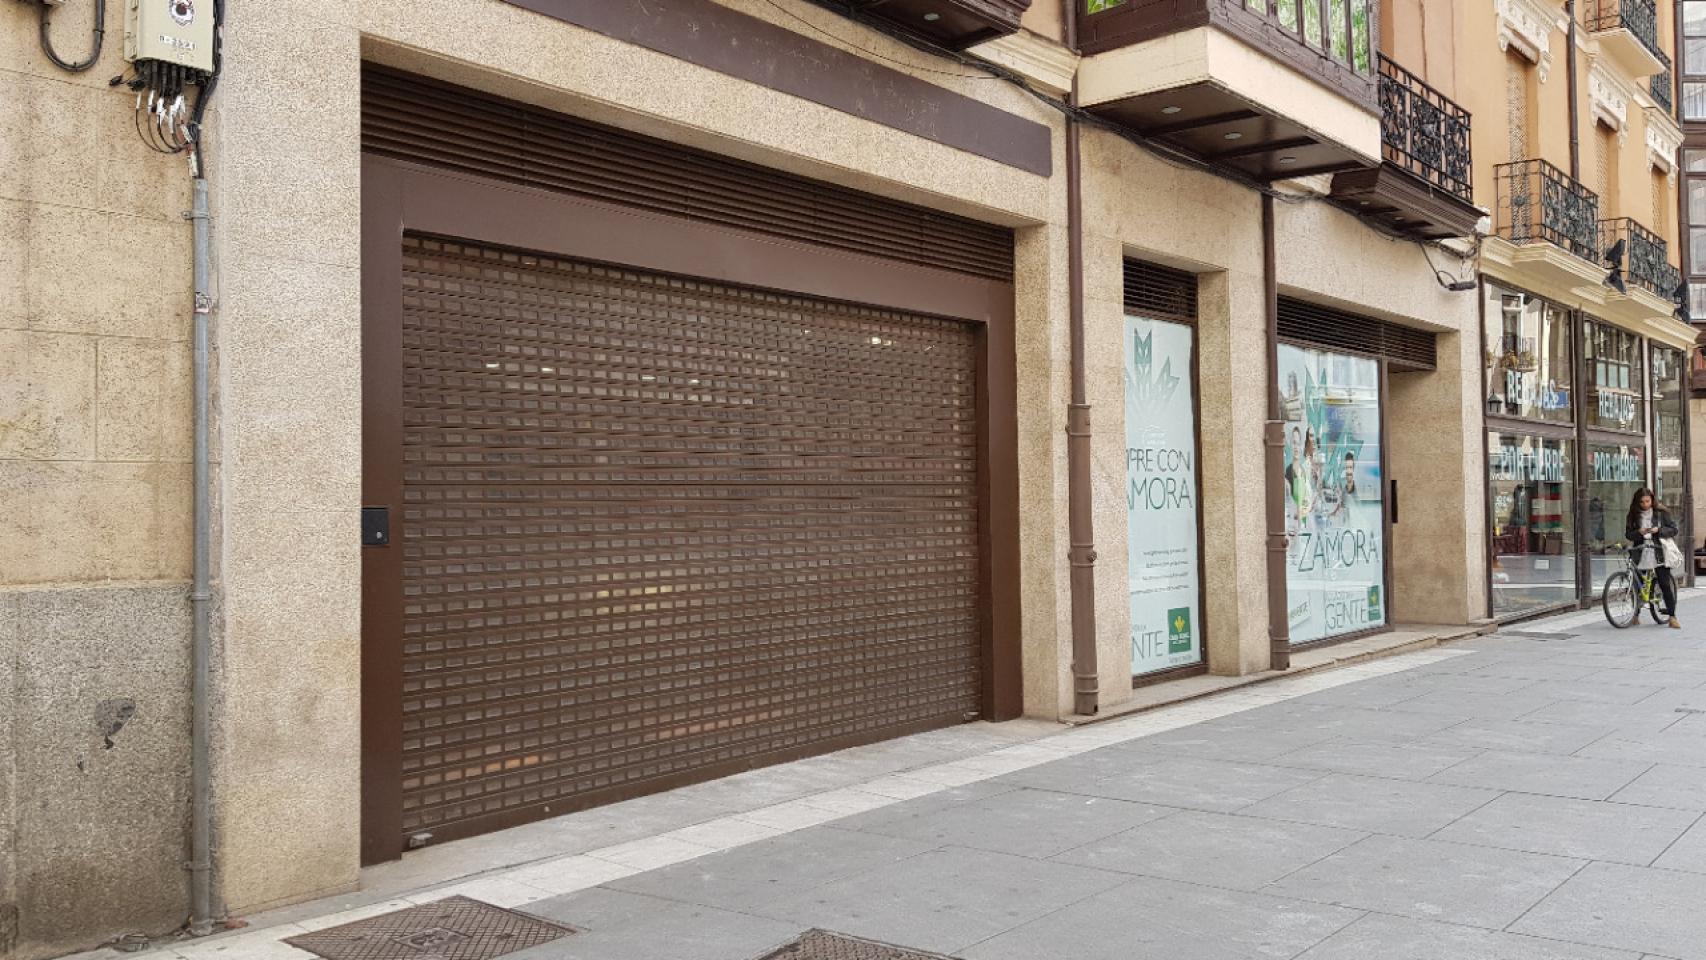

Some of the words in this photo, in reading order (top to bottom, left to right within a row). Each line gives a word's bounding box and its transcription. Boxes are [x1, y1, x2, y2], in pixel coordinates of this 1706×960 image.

[1157, 448, 1191, 472] CON
[1298, 528, 1379, 573] ZAMORA
[1325, 598, 1366, 630] GENTE
